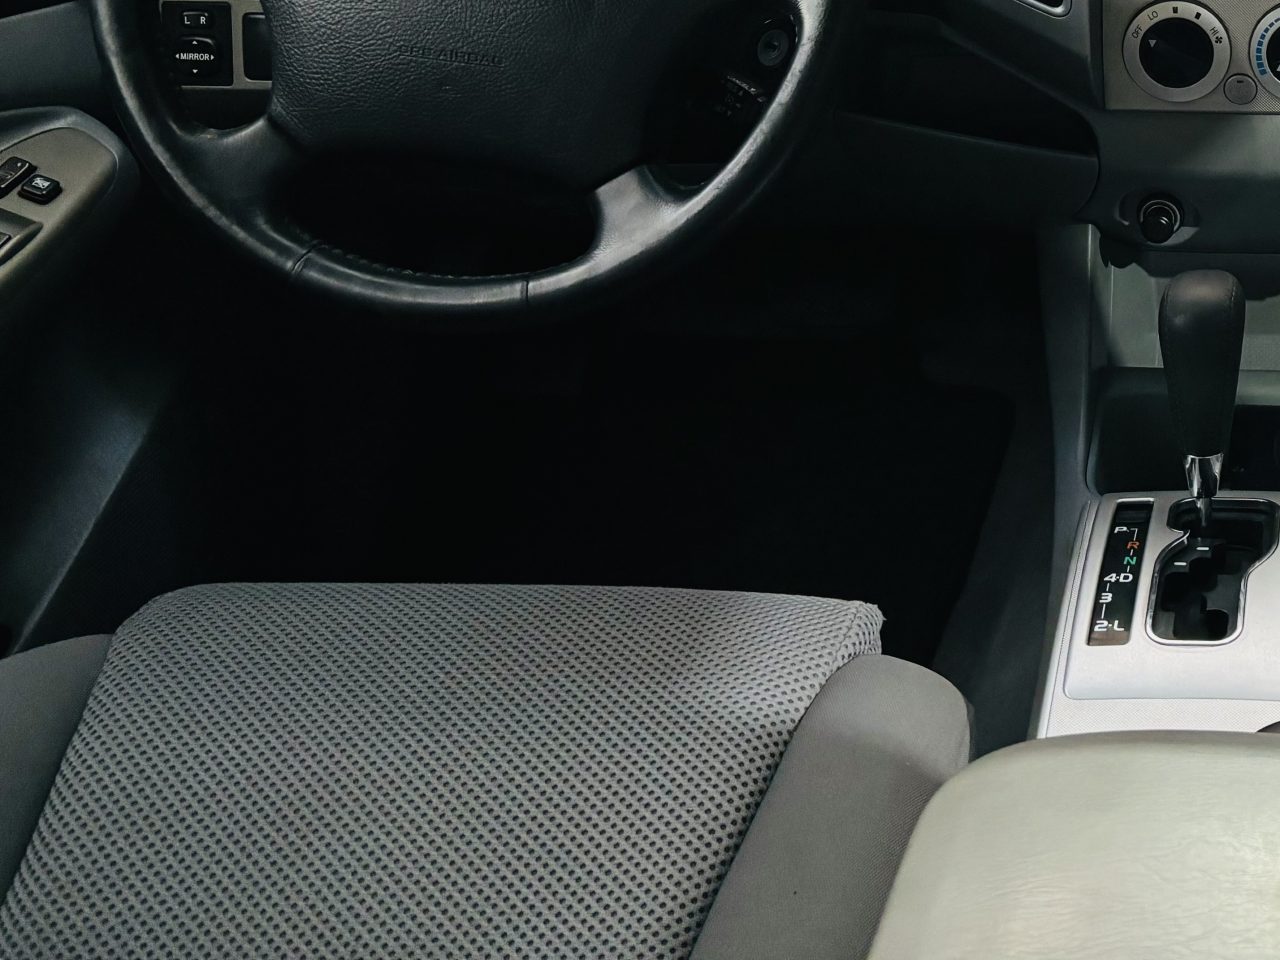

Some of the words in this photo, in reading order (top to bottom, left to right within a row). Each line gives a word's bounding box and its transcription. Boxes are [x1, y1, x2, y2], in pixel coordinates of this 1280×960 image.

[184, 16, 191, 24] L
[200, 16, 206, 24] R
[1146, 10, 1159, 21] LO
[1131, 25, 1143, 39] OFF
[1209, 26, 1220, 36] HI
[180, 52, 210, 61] MIRROR
[1114, 526, 1128, 534] P
[1127, 541, 1140, 549] R
[1123, 556, 1137, 565] N
[1099, 592, 1113, 603] 3
